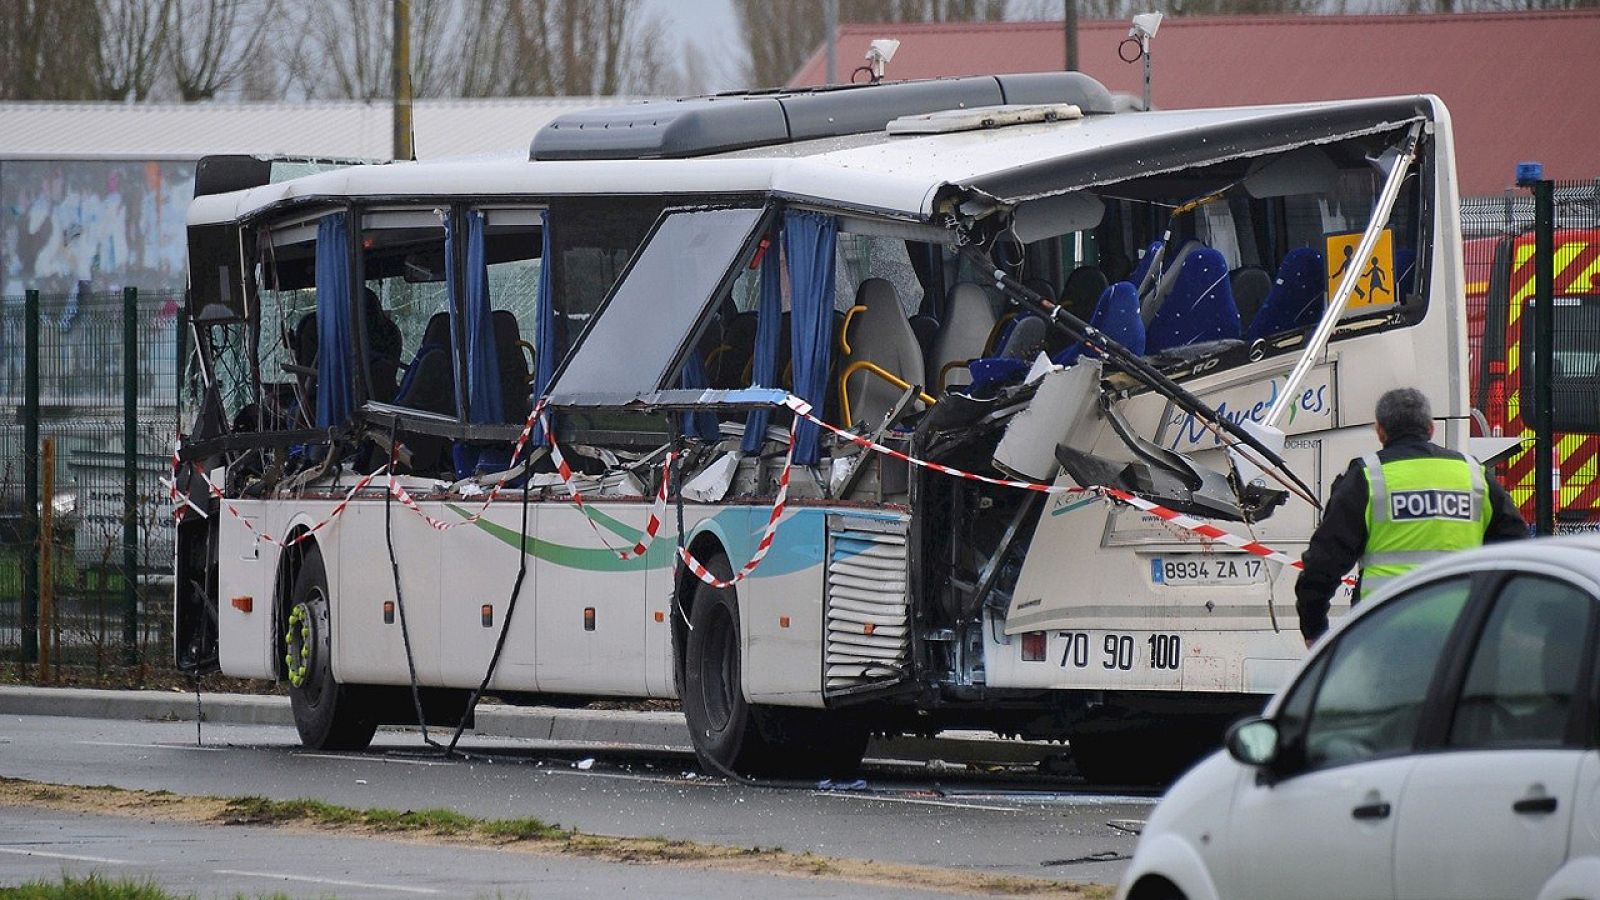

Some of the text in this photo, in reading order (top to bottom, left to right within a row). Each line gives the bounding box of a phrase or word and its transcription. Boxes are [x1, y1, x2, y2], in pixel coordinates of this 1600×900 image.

[1392, 493, 1471, 517] POLICE
[1164, 560, 1261, 580] 8934 ZA 17
[1059, 631, 1181, 671] 70 90 100
